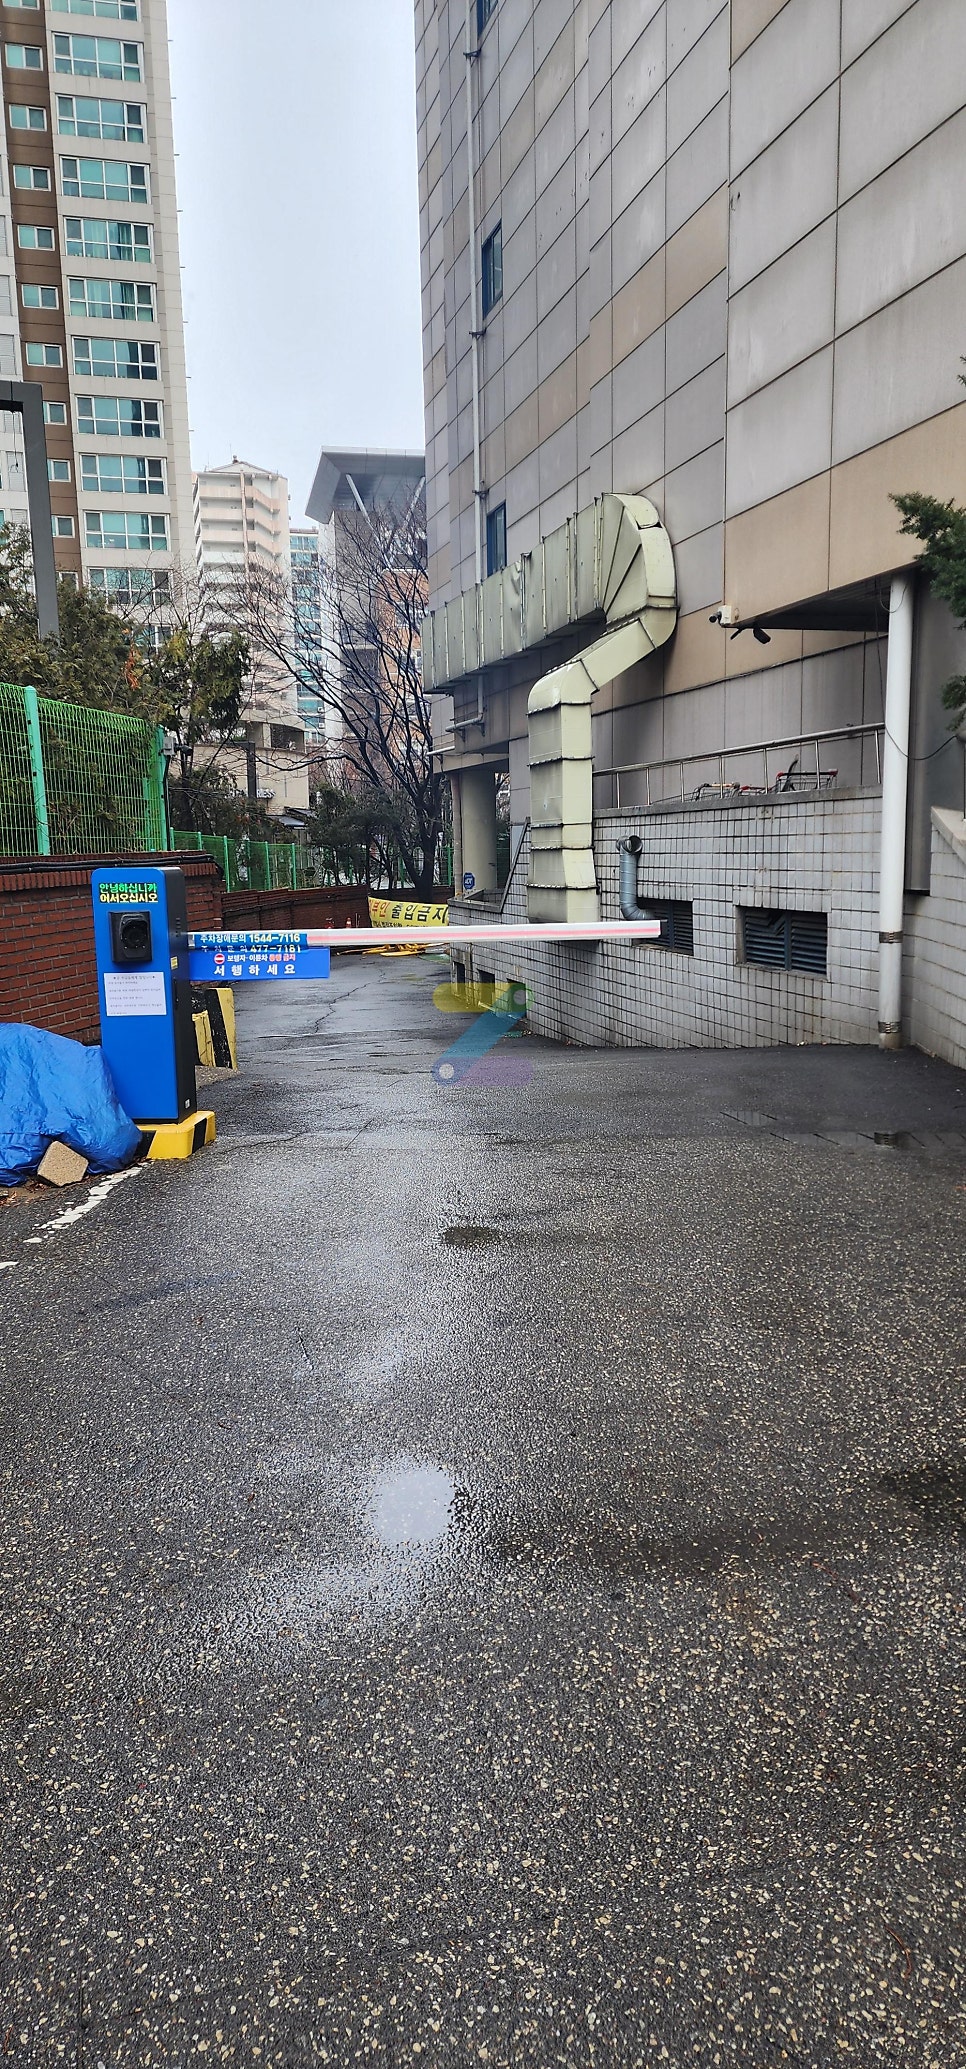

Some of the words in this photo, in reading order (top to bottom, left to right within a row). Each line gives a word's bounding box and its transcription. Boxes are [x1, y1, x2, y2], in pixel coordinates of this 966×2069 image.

[99, 882, 157, 894] 안녕하십니까
[100, 893, 159, 904] 어서오십시오
[391, 903, 449, 924] 출입금지
[249, 933, 301, 943] 1544-7116
[250, 944, 302, 954] 477-7181
